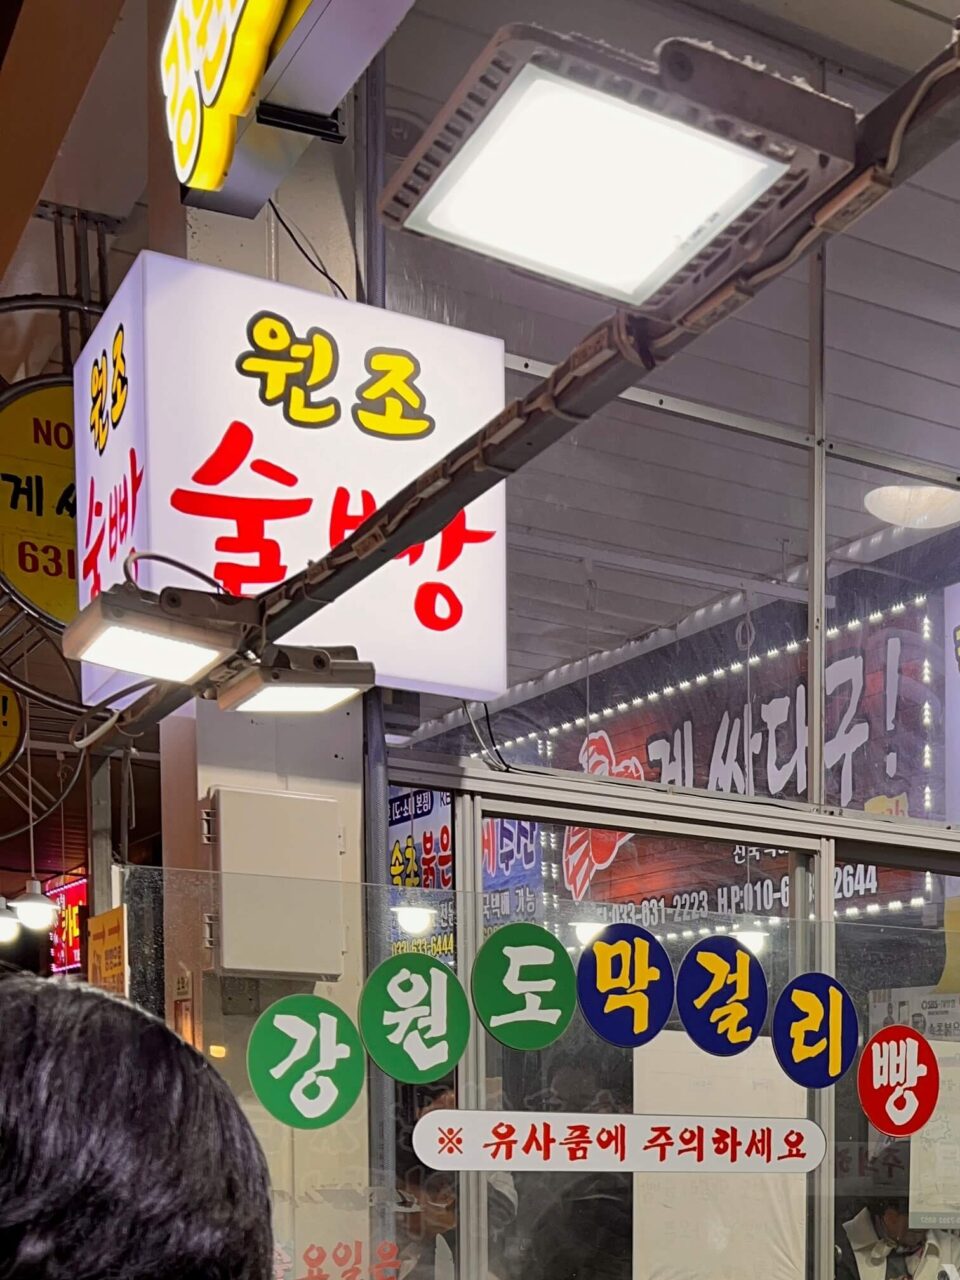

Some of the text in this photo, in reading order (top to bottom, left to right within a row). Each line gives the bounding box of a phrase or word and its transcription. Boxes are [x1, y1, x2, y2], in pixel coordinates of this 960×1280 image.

[90, 323, 128, 457] 원조
[236, 310, 435, 441] 원조
[170, 420, 497, 632] 술빵
[389, 825, 452, 892] 속초 붉은
[483, 1122, 627, 1162] 유사품에
[642, 1125, 808, 1163] 주의하세요
